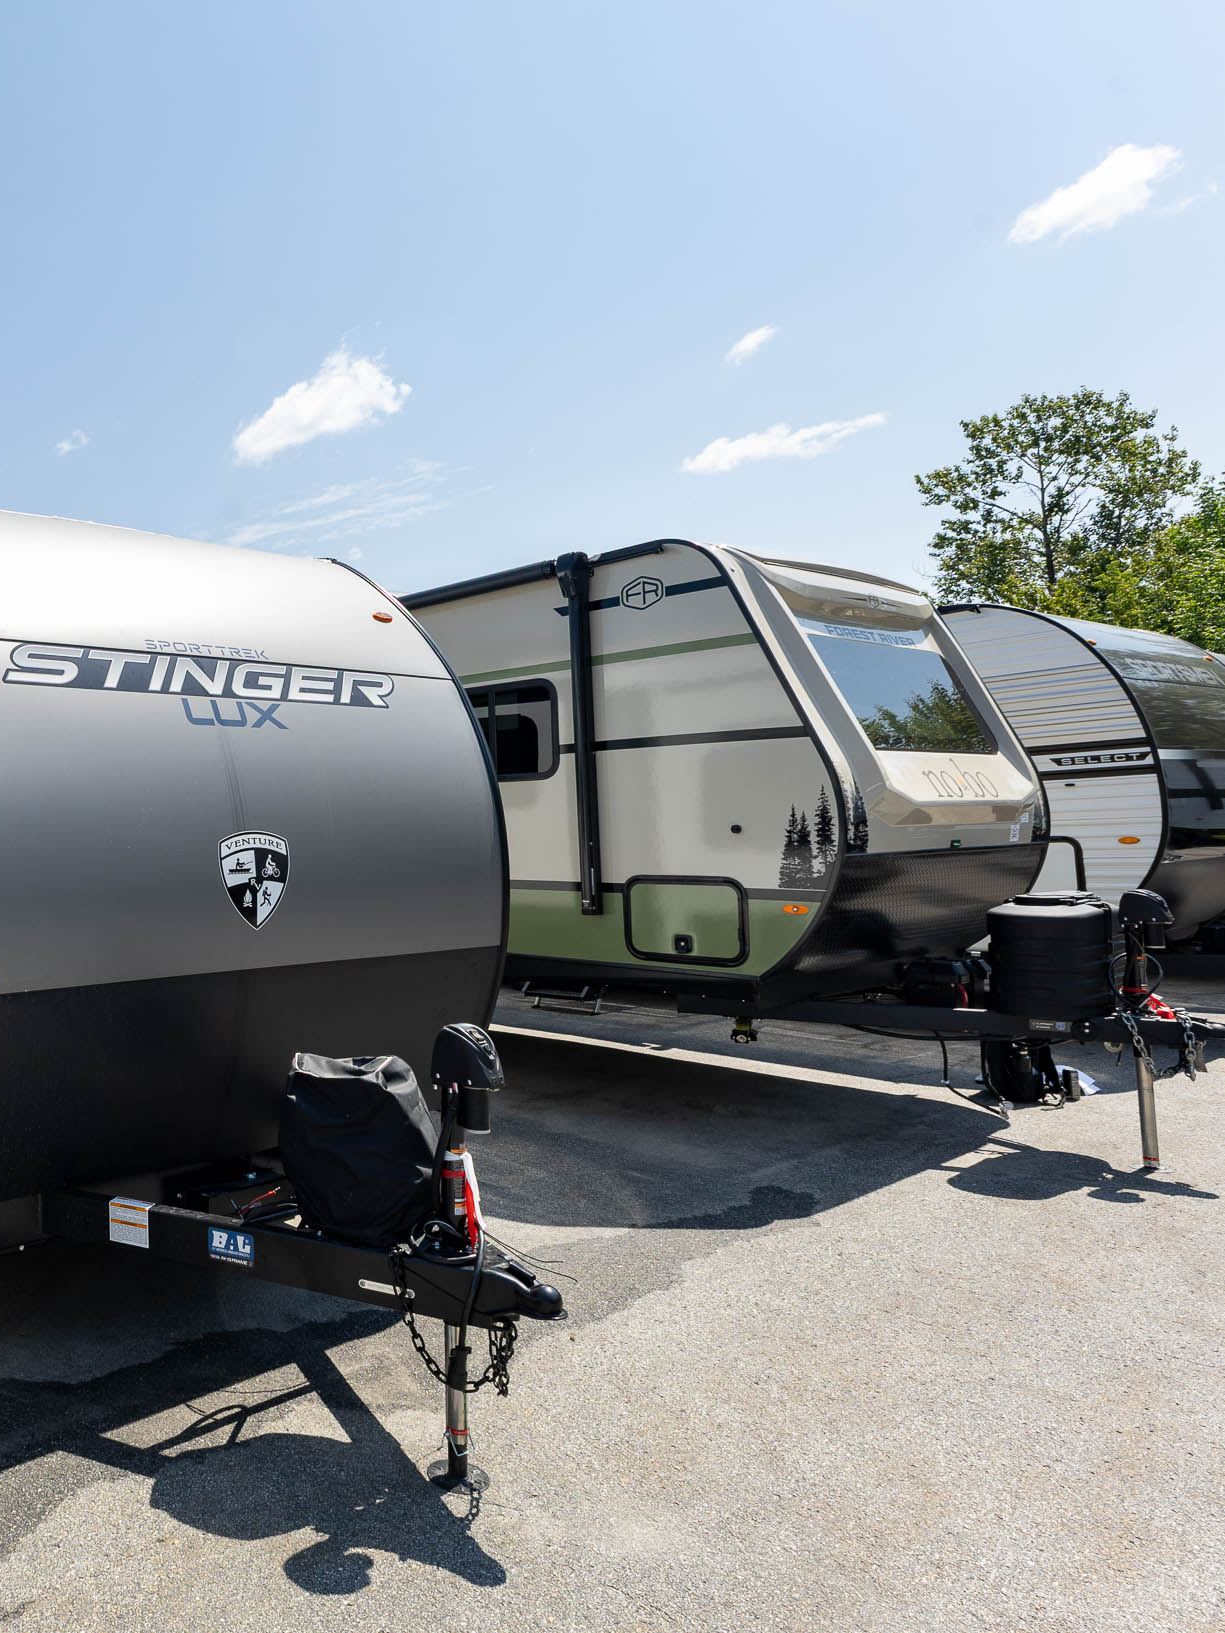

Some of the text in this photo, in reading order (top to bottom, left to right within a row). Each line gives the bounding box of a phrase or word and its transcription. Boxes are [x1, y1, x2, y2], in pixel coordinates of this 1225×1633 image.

[823, 624, 916, 646] FOREST RIVER
[144, 639, 269, 660] SPORTTREK
[3, 642, 394, 708] STINGER
[181, 698, 289, 730] LUX
[1060, 753, 1142, 766] SELECT
[225, 837, 283, 850] VENTURE
[250, 878, 262, 891] RV
[212, 1230, 251, 1254] BAL
